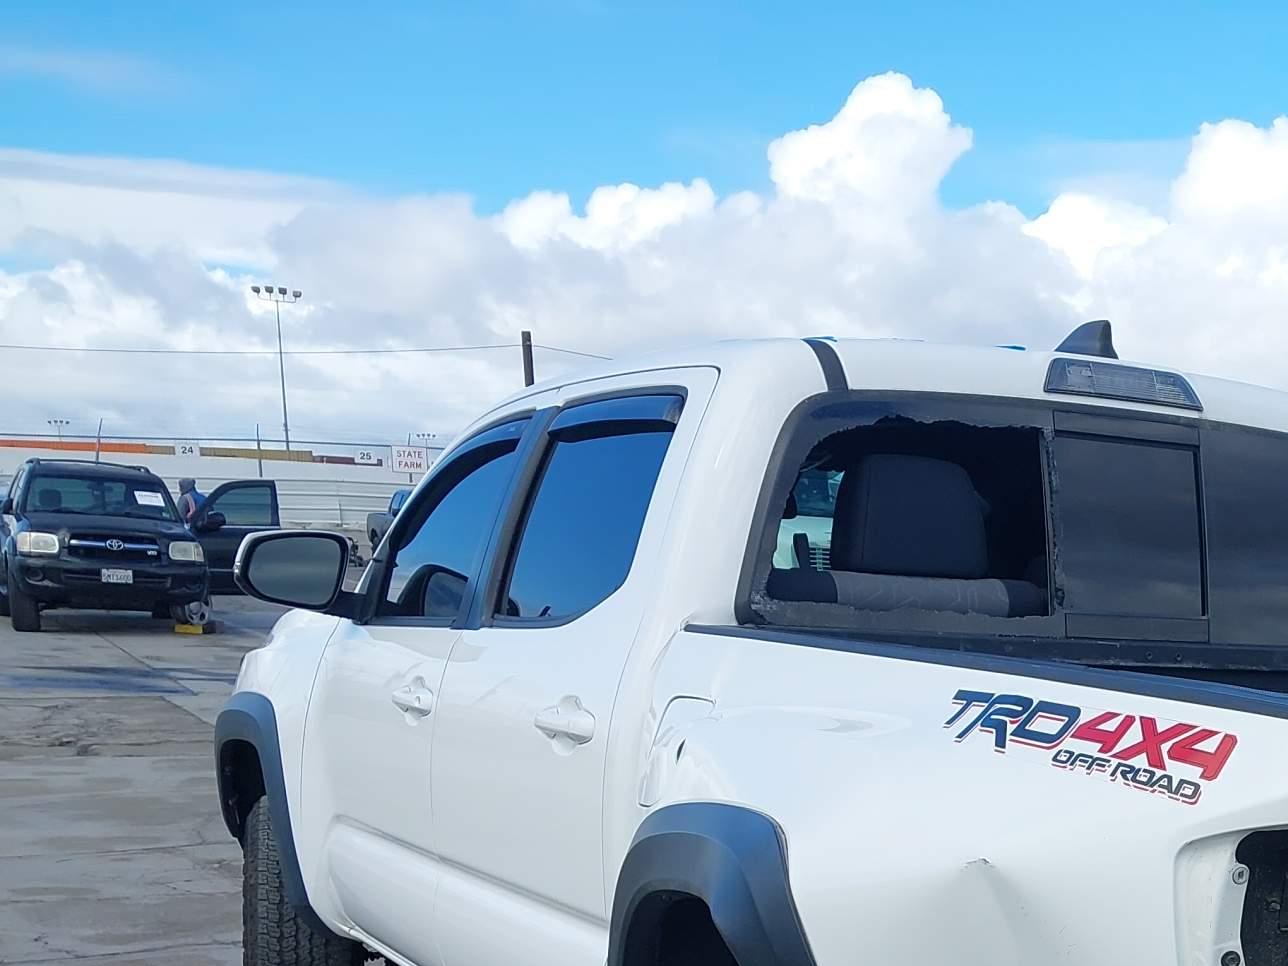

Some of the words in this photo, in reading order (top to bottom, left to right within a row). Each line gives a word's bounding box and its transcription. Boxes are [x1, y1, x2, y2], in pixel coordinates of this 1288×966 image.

[180, 446, 194, 455] 24
[396, 449, 424, 459] STATE
[359, 452, 372, 461] 25
[398, 460, 423, 470] FARM
[943, 688, 1082, 754] TRD
[1052, 749, 1112, 776] OFF
[1110, 762, 1203, 806] ROAD
